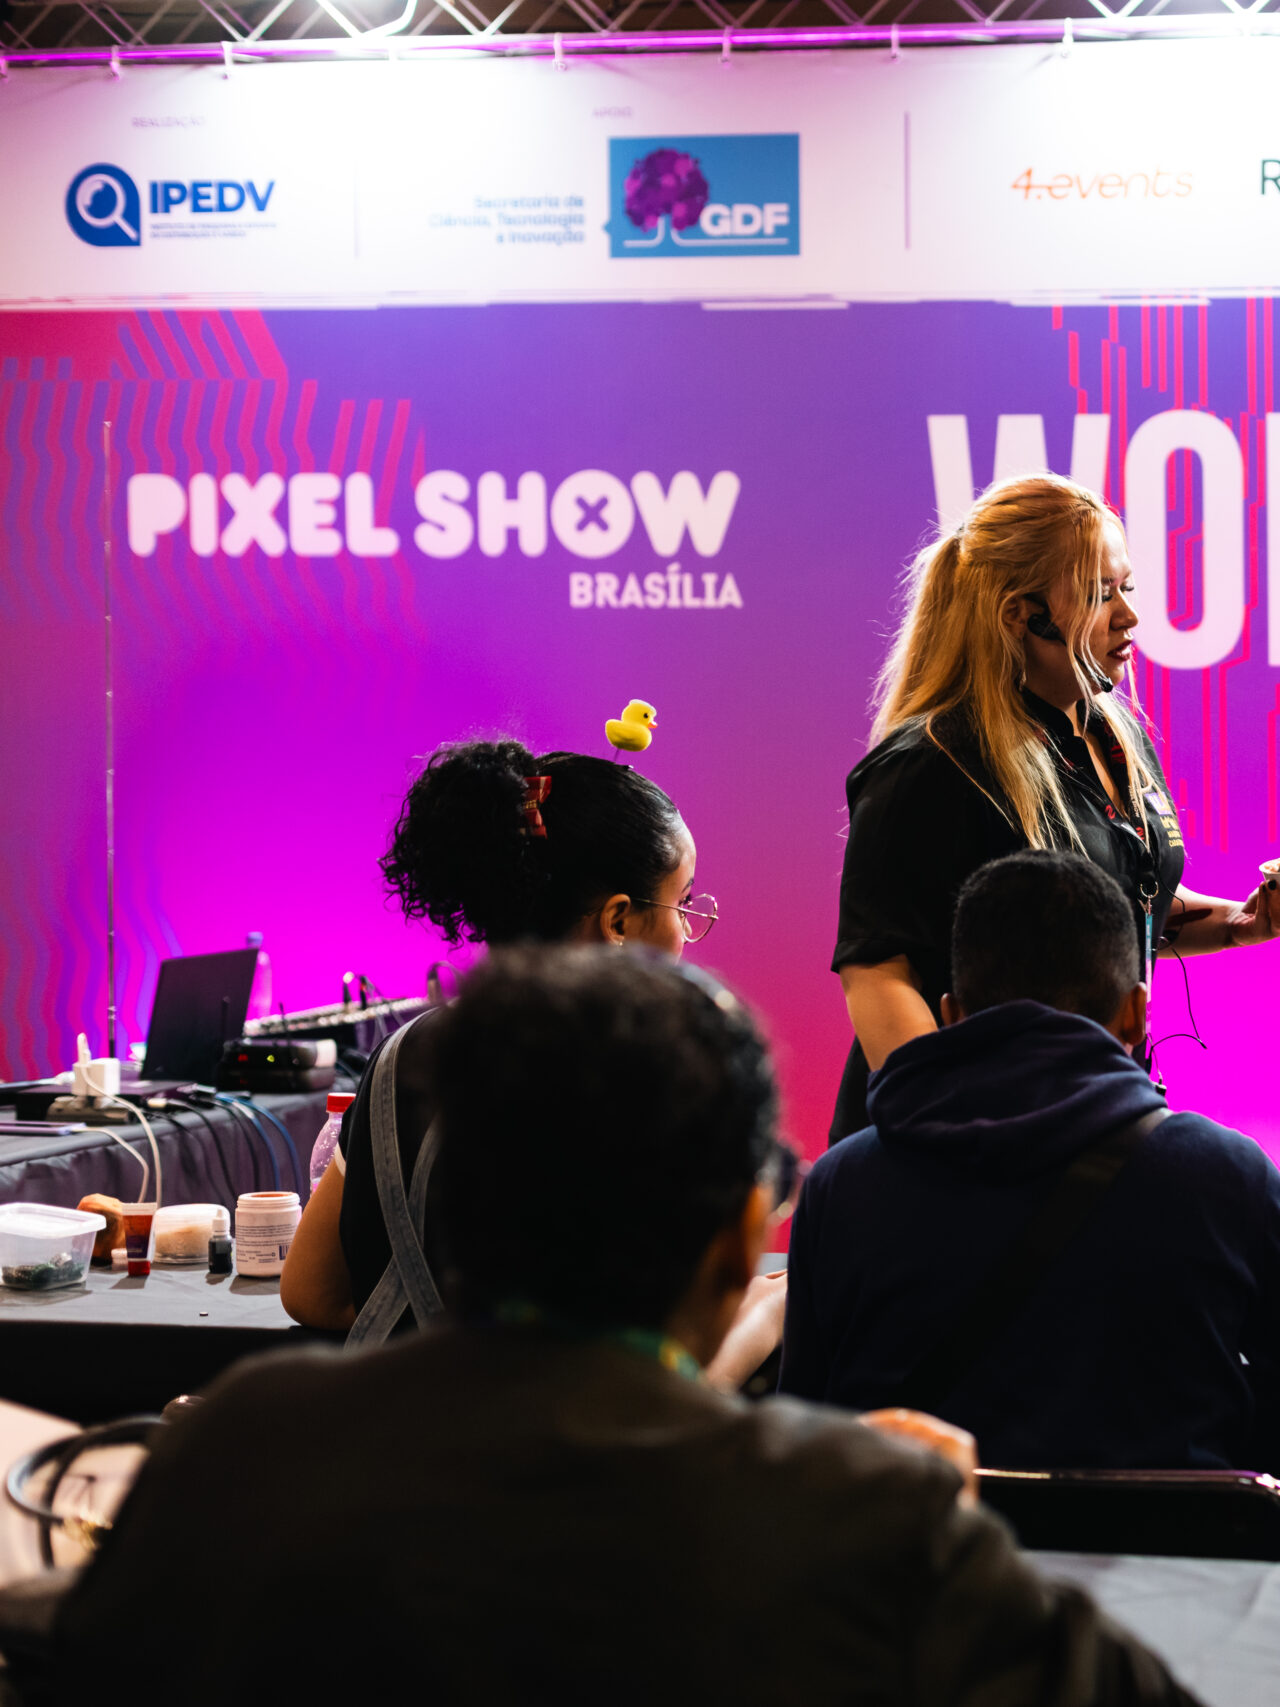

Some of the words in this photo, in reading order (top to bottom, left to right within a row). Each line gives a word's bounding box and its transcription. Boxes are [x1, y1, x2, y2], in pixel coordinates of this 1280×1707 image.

[150, 180, 275, 214] IPEDV
[700, 203, 789, 236] GDF
[127, 472, 399, 558] PIXEL
[413, 469, 741, 559] SHOW
[569, 563, 743, 609] BRASÍLIA
